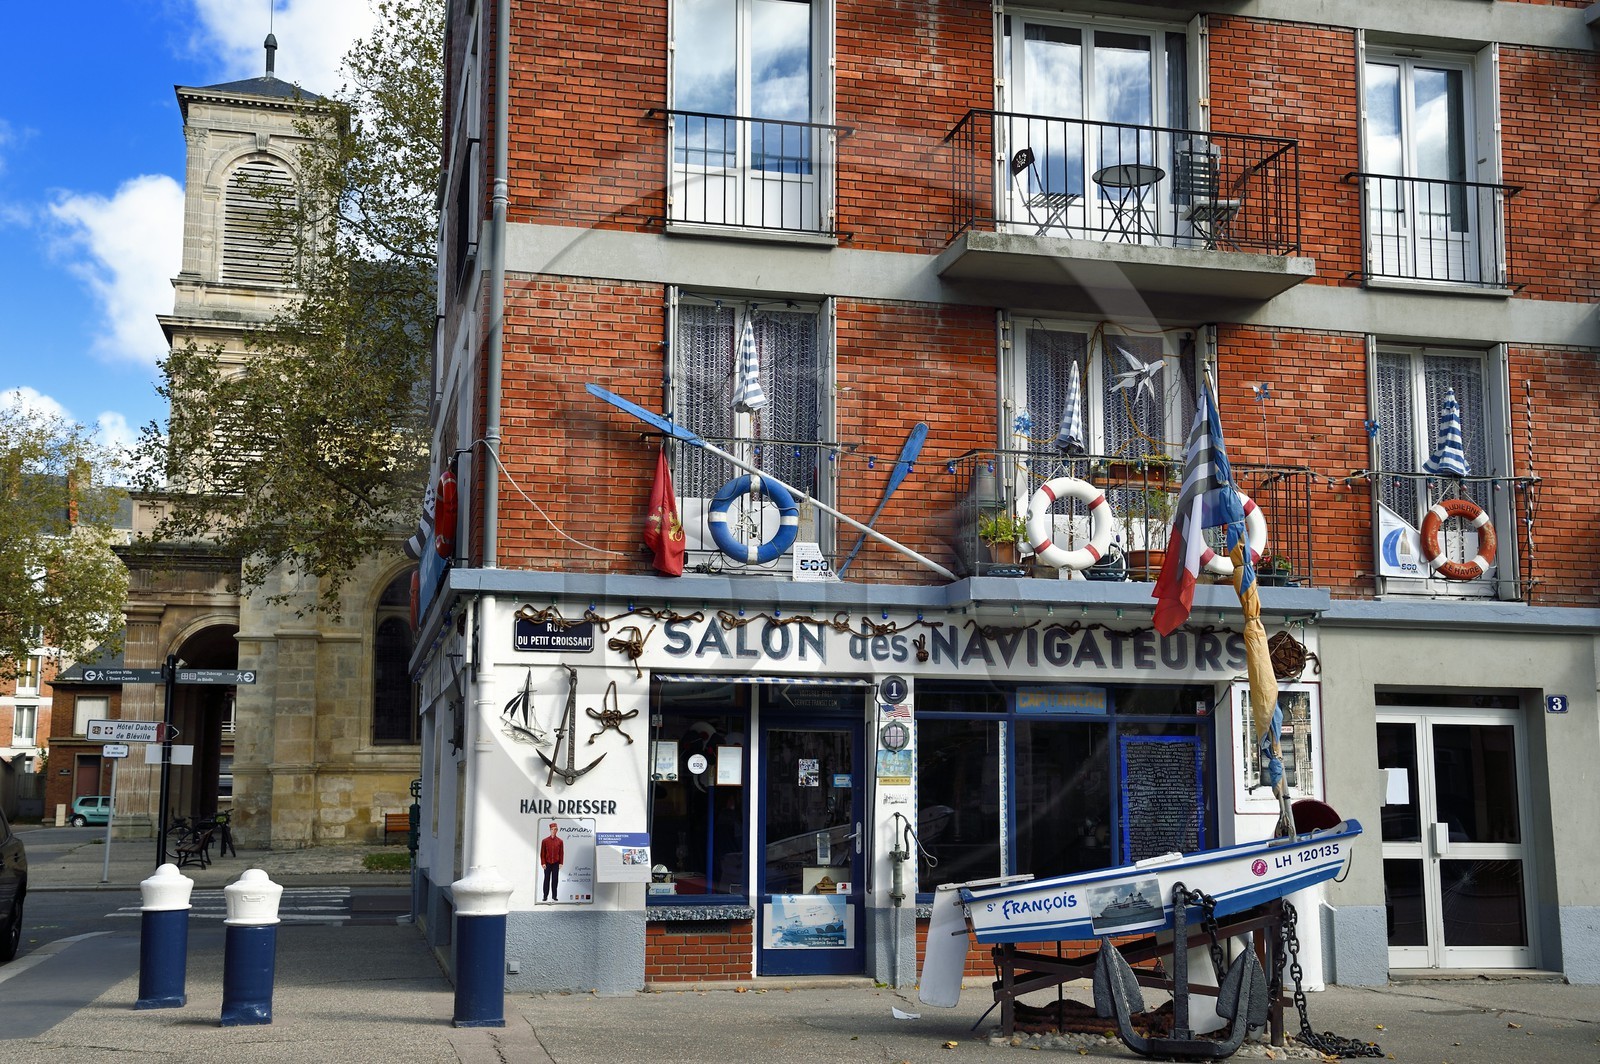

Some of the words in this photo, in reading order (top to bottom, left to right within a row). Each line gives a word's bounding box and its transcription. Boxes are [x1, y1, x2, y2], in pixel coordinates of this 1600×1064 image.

[1445, 503, 1480, 517] AUDIERNE
[800, 560, 829, 571] 500
[1444, 562, 1452, 572] LE
[1454, 566, 1480, 575] HAVRE
[546, 622, 564, 632] RUE
[518, 635, 528, 645] DU
[530, 636, 549, 646] PETIT
[551, 636, 592, 646] CROISSANT
[663, 617, 826, 665] SALON
[849, 624, 909, 662] des
[931, 623, 1248, 672] NAVIGATEURS
[891, 682, 897, 696] 1
[1018, 691, 1105, 708] CAPITAINERIE
[1552, 697, 1562, 710] 3
[520, 799, 552, 814] HAIR
[558, 799, 616, 814] DRESSER
[1275, 854, 1292, 869] LH
[1298, 844, 1340, 863] 120135
[1002, 892, 1077, 920] FRANÇOIS
